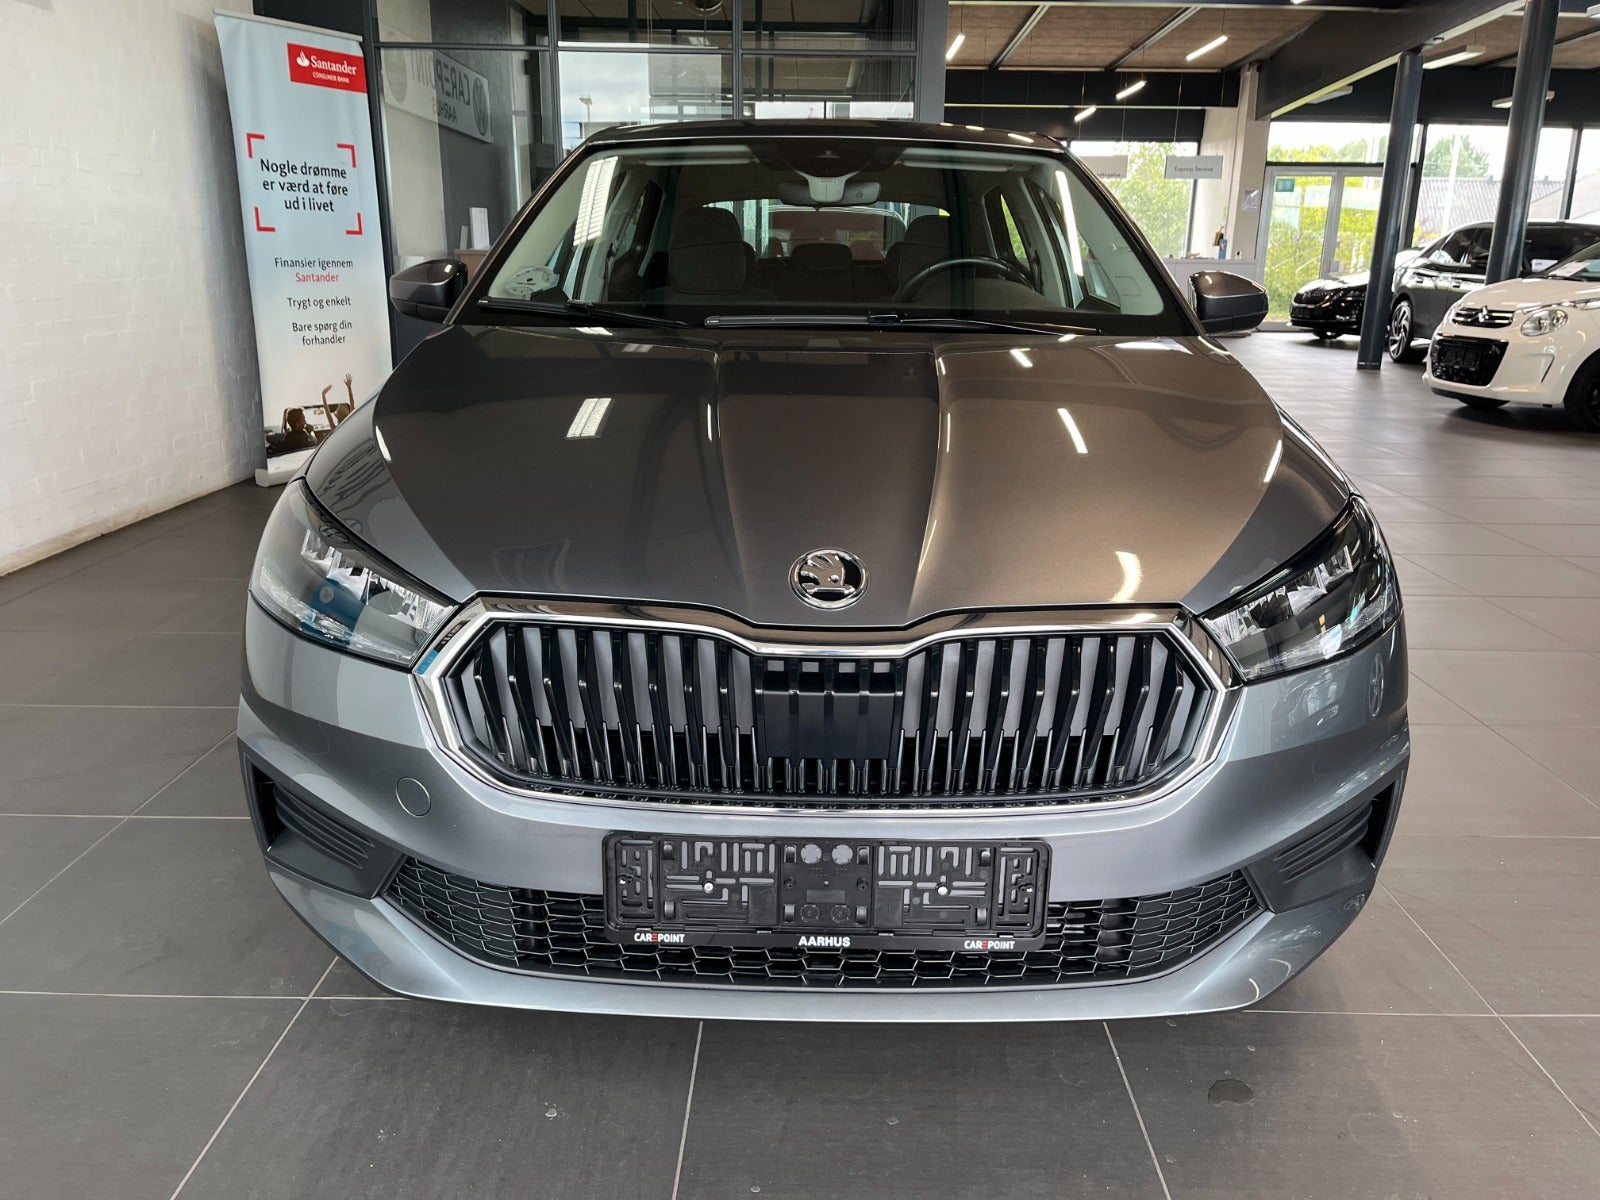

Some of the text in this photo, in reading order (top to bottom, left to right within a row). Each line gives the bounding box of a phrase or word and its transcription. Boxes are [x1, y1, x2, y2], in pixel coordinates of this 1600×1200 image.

[310, 54, 357, 76] Santander
[260, 158, 347, 179] Nogle drømme
[262, 180, 348, 196] er værd at føre
[284, 197, 300, 210] ud
[308, 197, 335, 212] livet
[274, 257, 354, 270] Finansier igennem
[295, 272, 339, 283] Santander
[287, 296, 352, 310] Trygt og enkelt
[292, 320, 353, 333] Bare spørg din
[302, 335, 346, 346] forhandler
[798, 935, 851, 947] AARHUS
